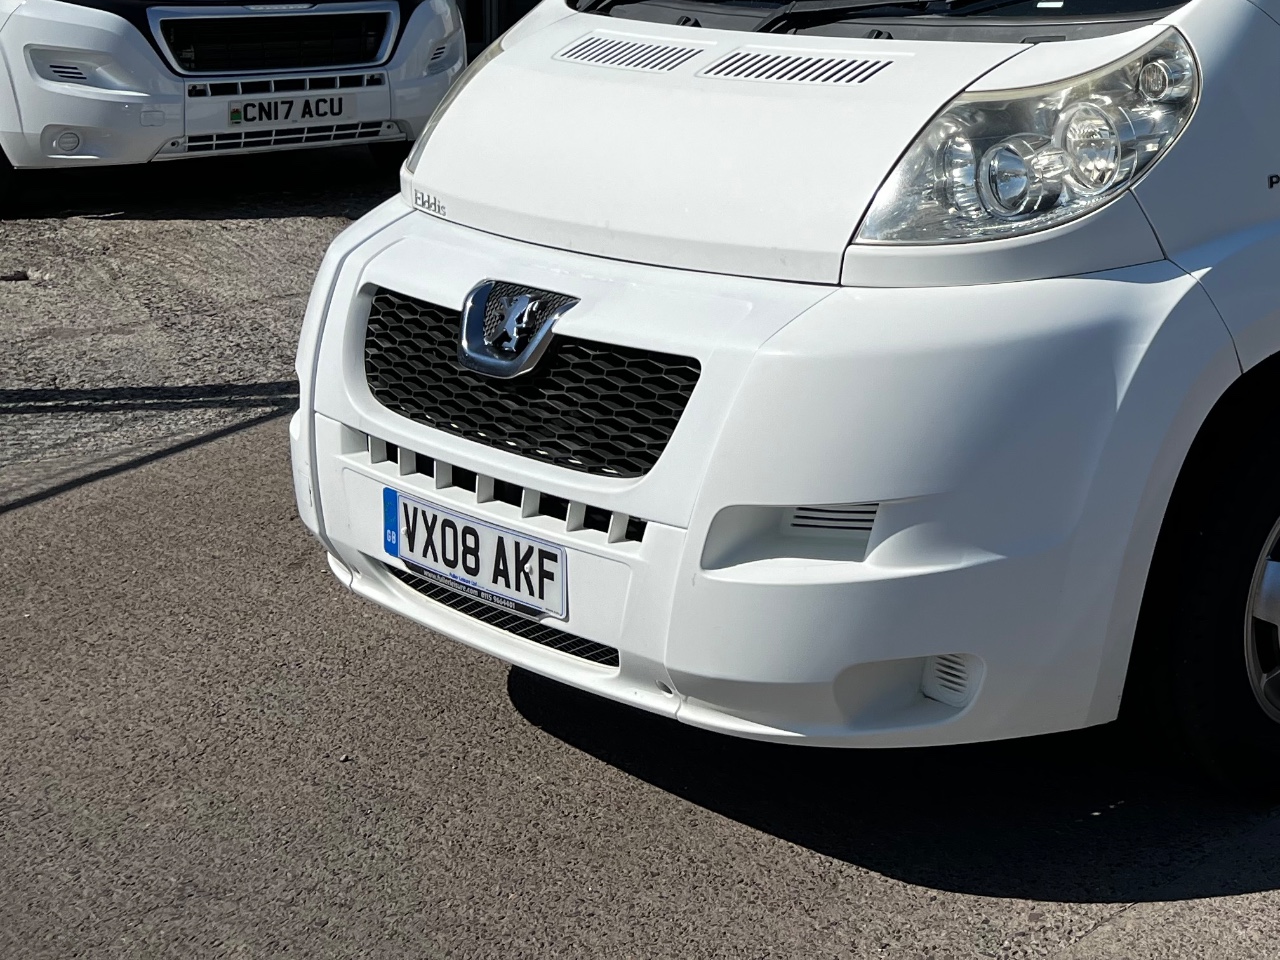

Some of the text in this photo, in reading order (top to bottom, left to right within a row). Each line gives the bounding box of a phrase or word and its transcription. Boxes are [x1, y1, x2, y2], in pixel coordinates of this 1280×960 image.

[243, 97, 343, 122] CN17 ACU
[414, 189, 447, 217] Elddis
[386, 529, 397, 544] GB
[403, 502, 559, 600] VX08 AKF
